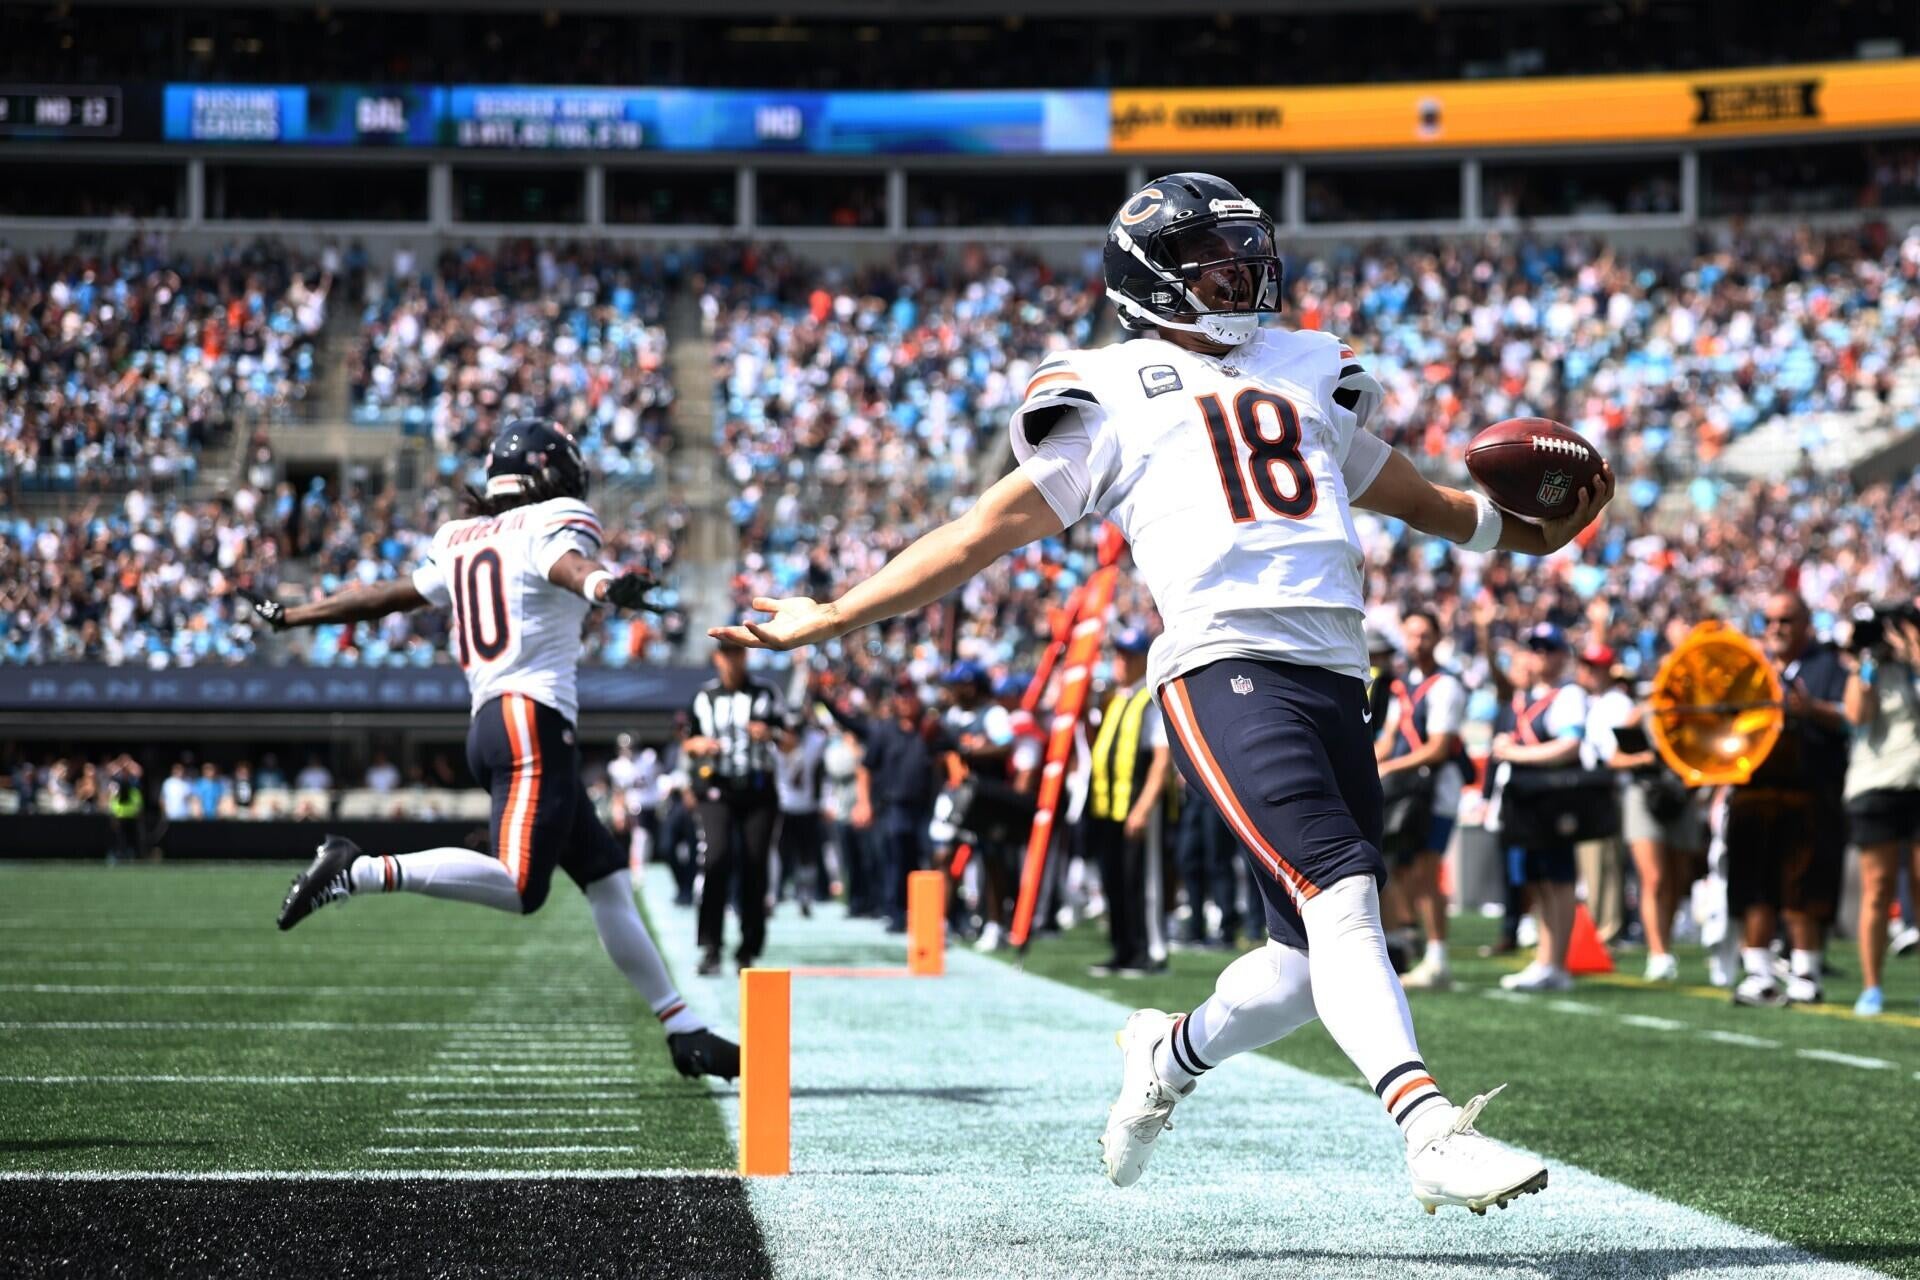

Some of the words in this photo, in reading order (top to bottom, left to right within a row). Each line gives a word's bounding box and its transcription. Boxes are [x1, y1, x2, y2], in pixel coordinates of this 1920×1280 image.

[1194, 386, 1318, 524] 18
[454, 547, 510, 669] 10
[31, 679, 178, 698] BANK
[287, 679, 467, 698] AMERI
